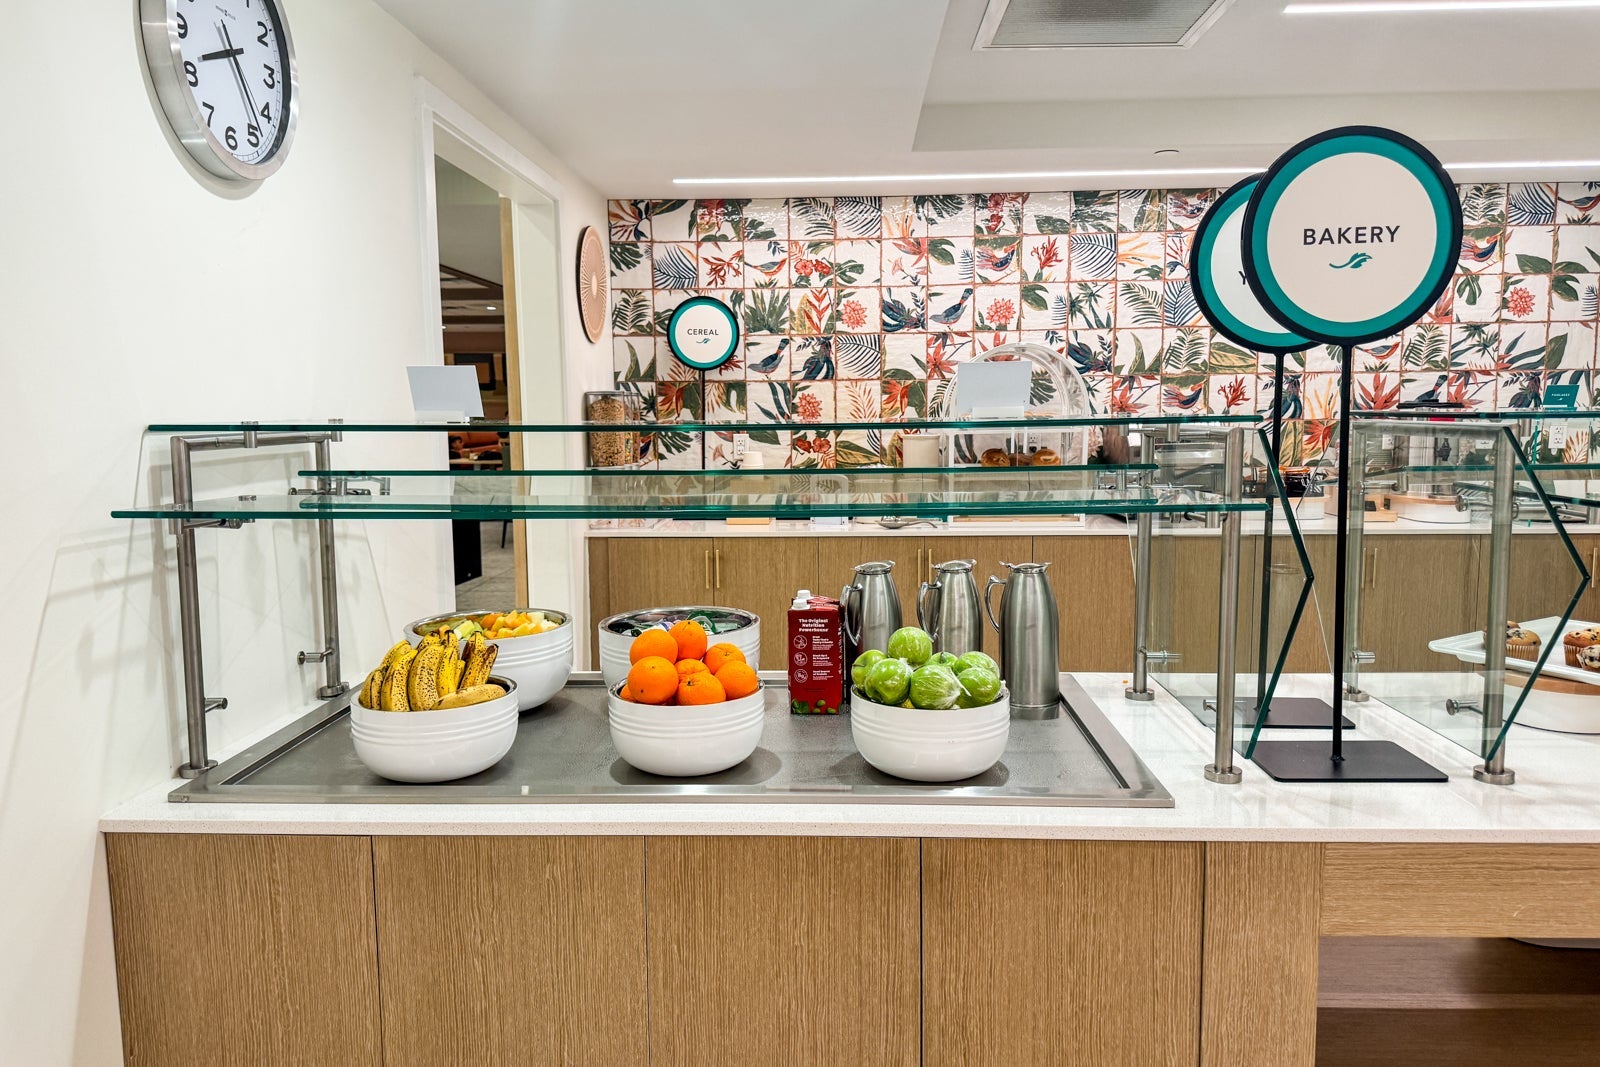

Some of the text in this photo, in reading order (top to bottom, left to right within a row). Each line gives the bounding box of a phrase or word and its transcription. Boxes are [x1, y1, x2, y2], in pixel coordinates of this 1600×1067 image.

[177, 12, 188, 39] 9
[257, 21, 269, 47] 2
[184, 61, 199, 87] 8
[263, 63, 275, 89] 3
[202, 101, 215, 128] 7
[261, 102, 272, 124] 4
[225, 126, 238, 151] 6
[246, 123, 260, 148] 5
[1303, 225, 1400, 246] BAKERY
[687, 328, 719, 336] CEREAL
